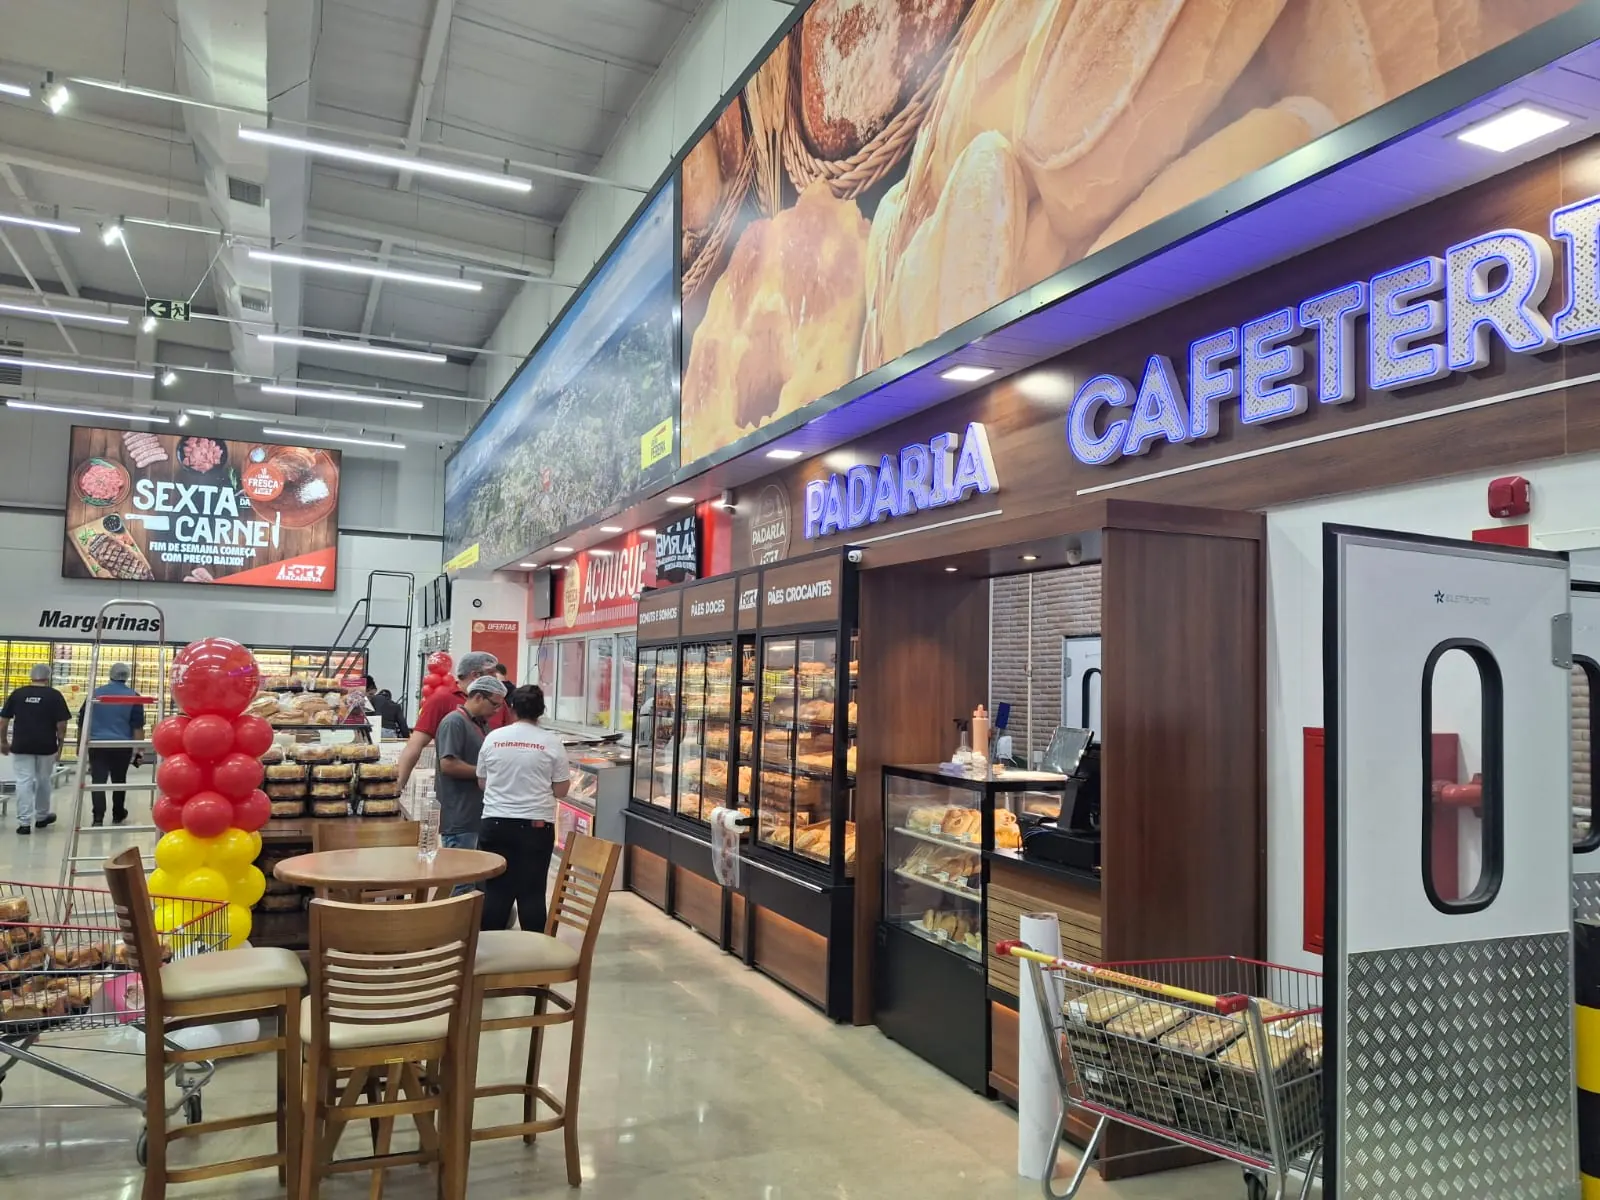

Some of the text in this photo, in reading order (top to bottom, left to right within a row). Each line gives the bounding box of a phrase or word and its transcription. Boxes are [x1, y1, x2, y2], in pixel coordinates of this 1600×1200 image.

[248, 478, 279, 489] FRESCA
[804, 421, 999, 539] PADARIA
[133, 478, 238, 517] SEXTA
[240, 498, 251, 507] DA
[752, 521, 785, 545] PADARIA
[149, 541, 257, 559] FIM DE SEMANA COMEÇA
[161, 552, 244, 567] COM PREÇO BAIXO!
[584, 541, 649, 615] AÇOUGUE
[785, 579, 832, 603] CROCANTES
[705, 599, 725, 614] DOCES
[38, 610, 160, 632] Margarinas
[493, 741, 545, 751] Treinamento
